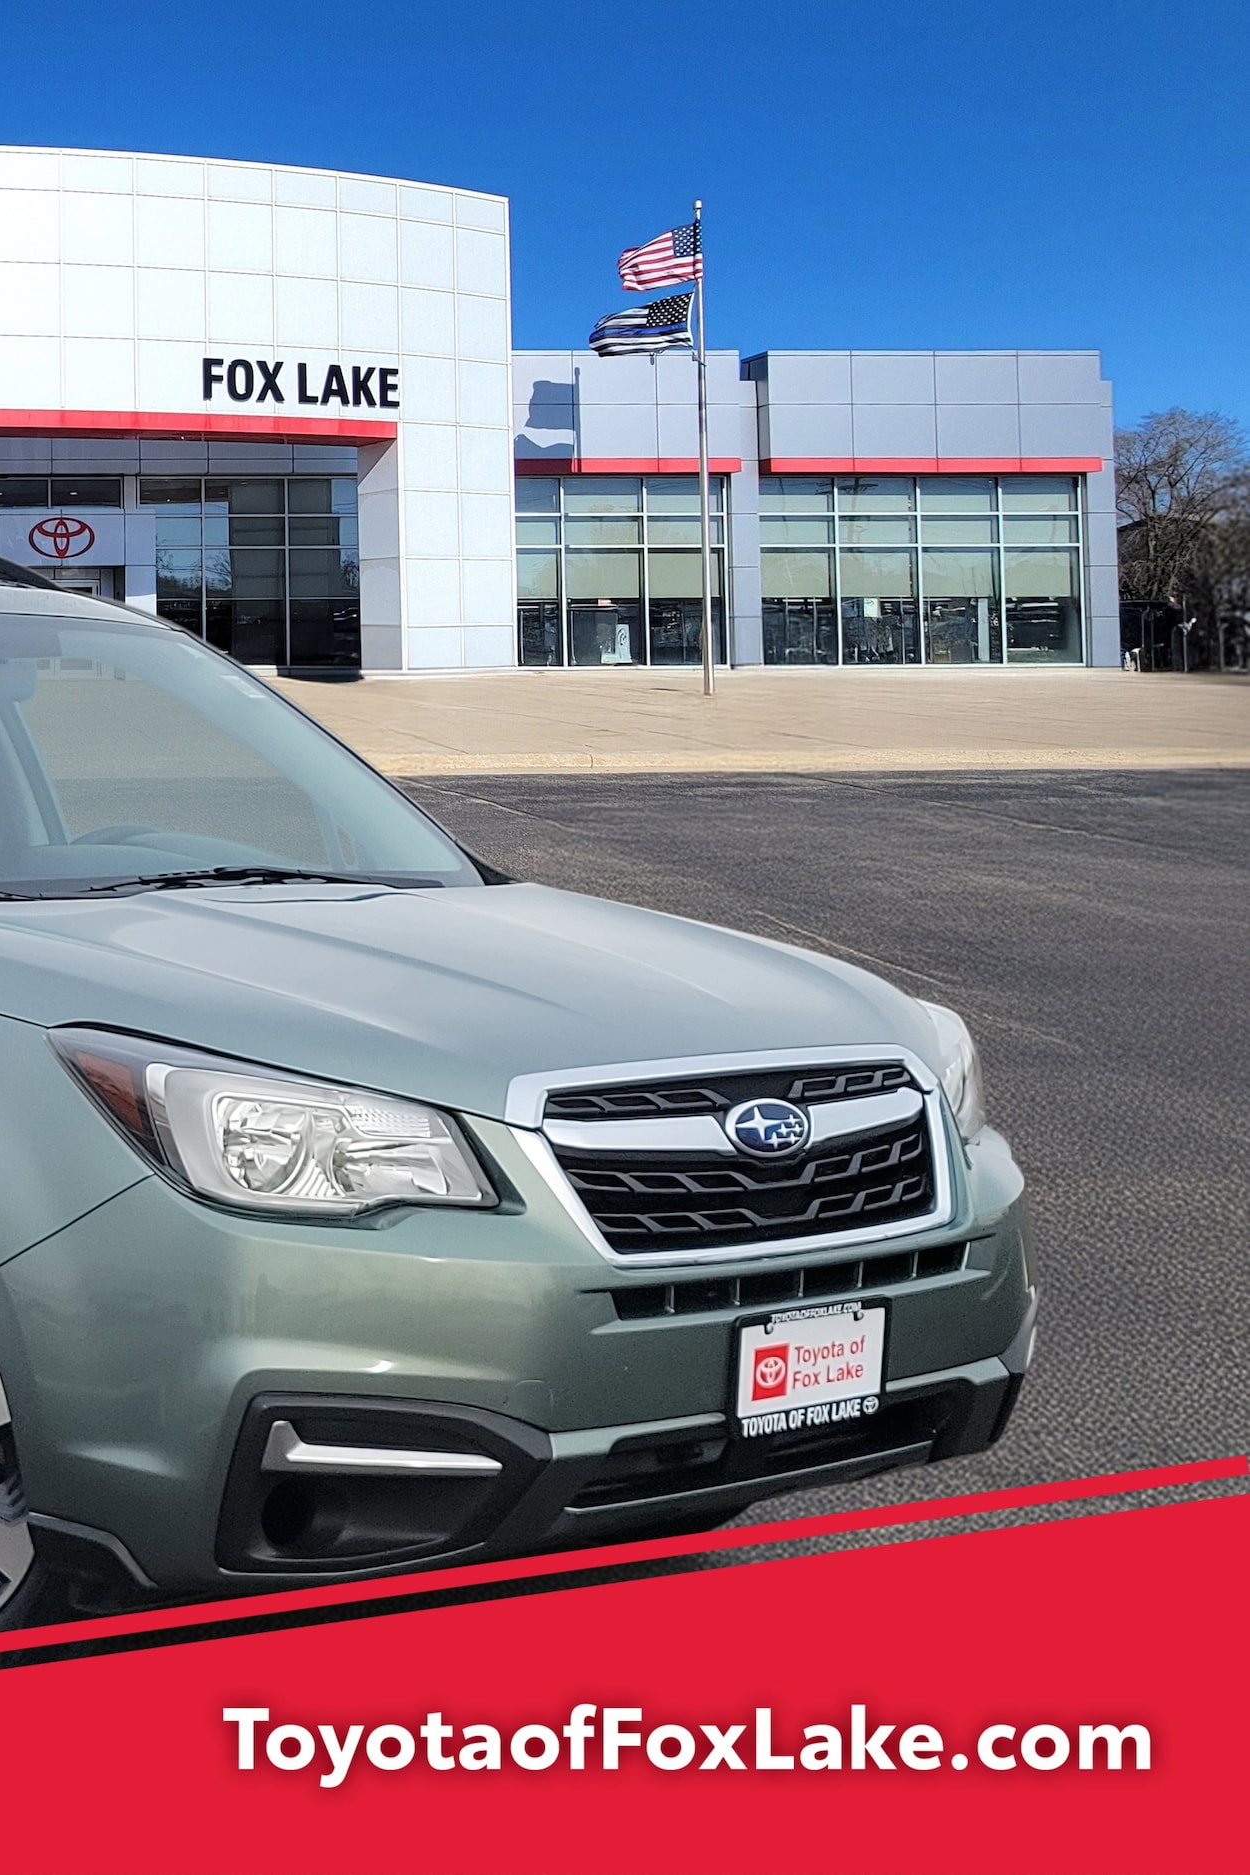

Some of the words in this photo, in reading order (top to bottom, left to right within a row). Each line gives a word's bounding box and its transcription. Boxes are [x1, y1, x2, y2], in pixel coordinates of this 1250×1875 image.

[202, 357, 285, 403] FOX
[297, 362, 400, 408] LAKE
[794, 1340, 845, 1367] Toyota
[850, 1334, 866, 1355] of
[792, 1370, 821, 1390] Fox
[826, 1362, 864, 1383] Lake
[741, 1413, 788, 1438] TOYOTA
[788, 1409, 806, 1430] OF
[806, 1404, 831, 1426] FOX
[831, 1398, 862, 1420] LAKE
